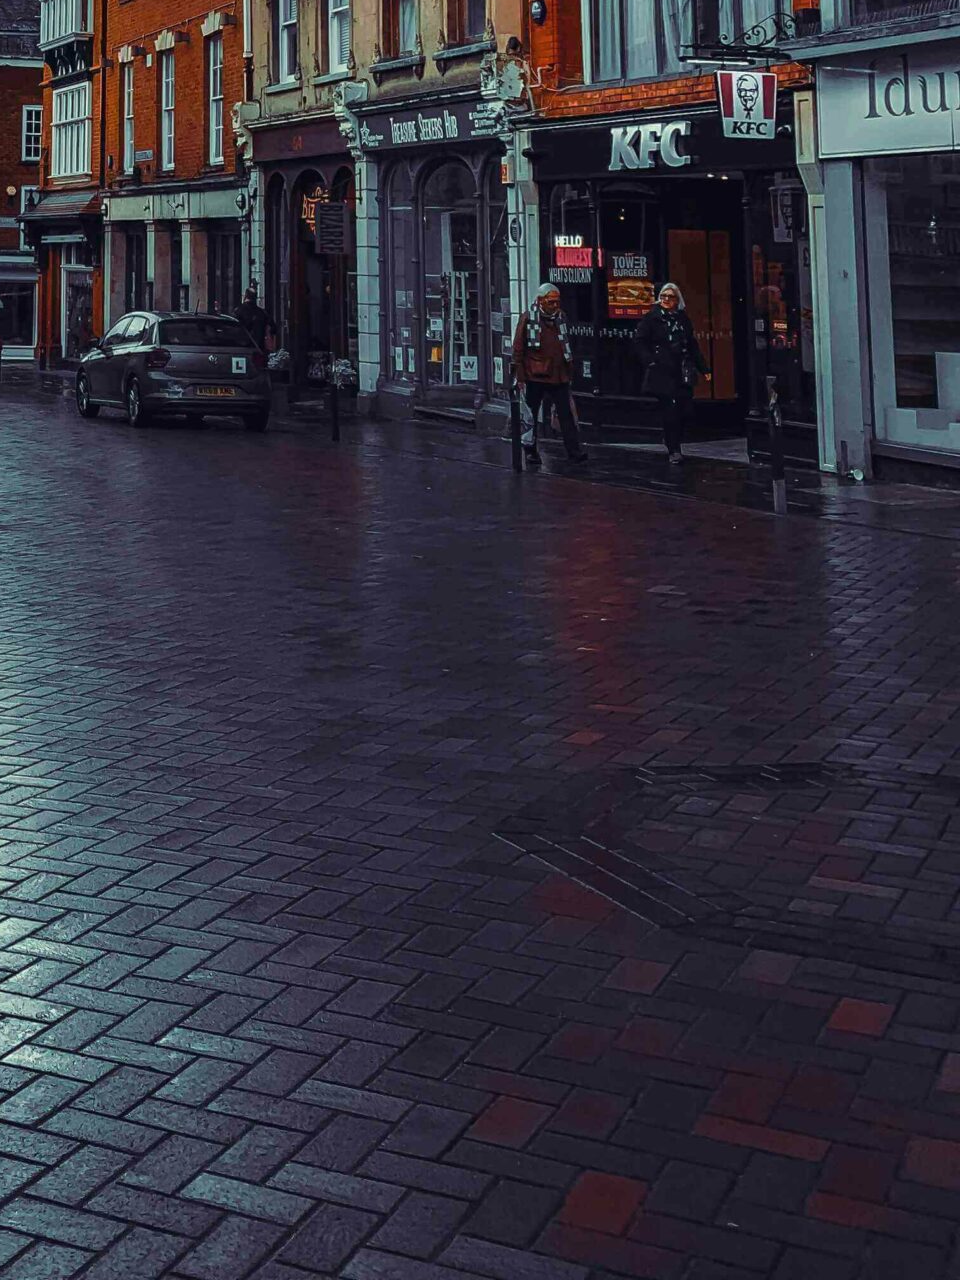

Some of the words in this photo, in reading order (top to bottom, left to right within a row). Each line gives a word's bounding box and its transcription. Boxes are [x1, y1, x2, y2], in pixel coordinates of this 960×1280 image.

[864, 53, 960, 119] Idu
[390, 117, 416, 144] TREASURE
[418, 113, 444, 141] SEEKERS
[443, 109, 458, 138] HUB
[730, 121, 768, 136] KFC
[608, 120, 691, 171] KFC
[555, 234, 582, 247] HELLO
[612, 256, 647, 269] TOWER
[613, 269, 648, 277] BURGERS
[235, 360, 243, 370] L
[463, 361, 475, 369] W
